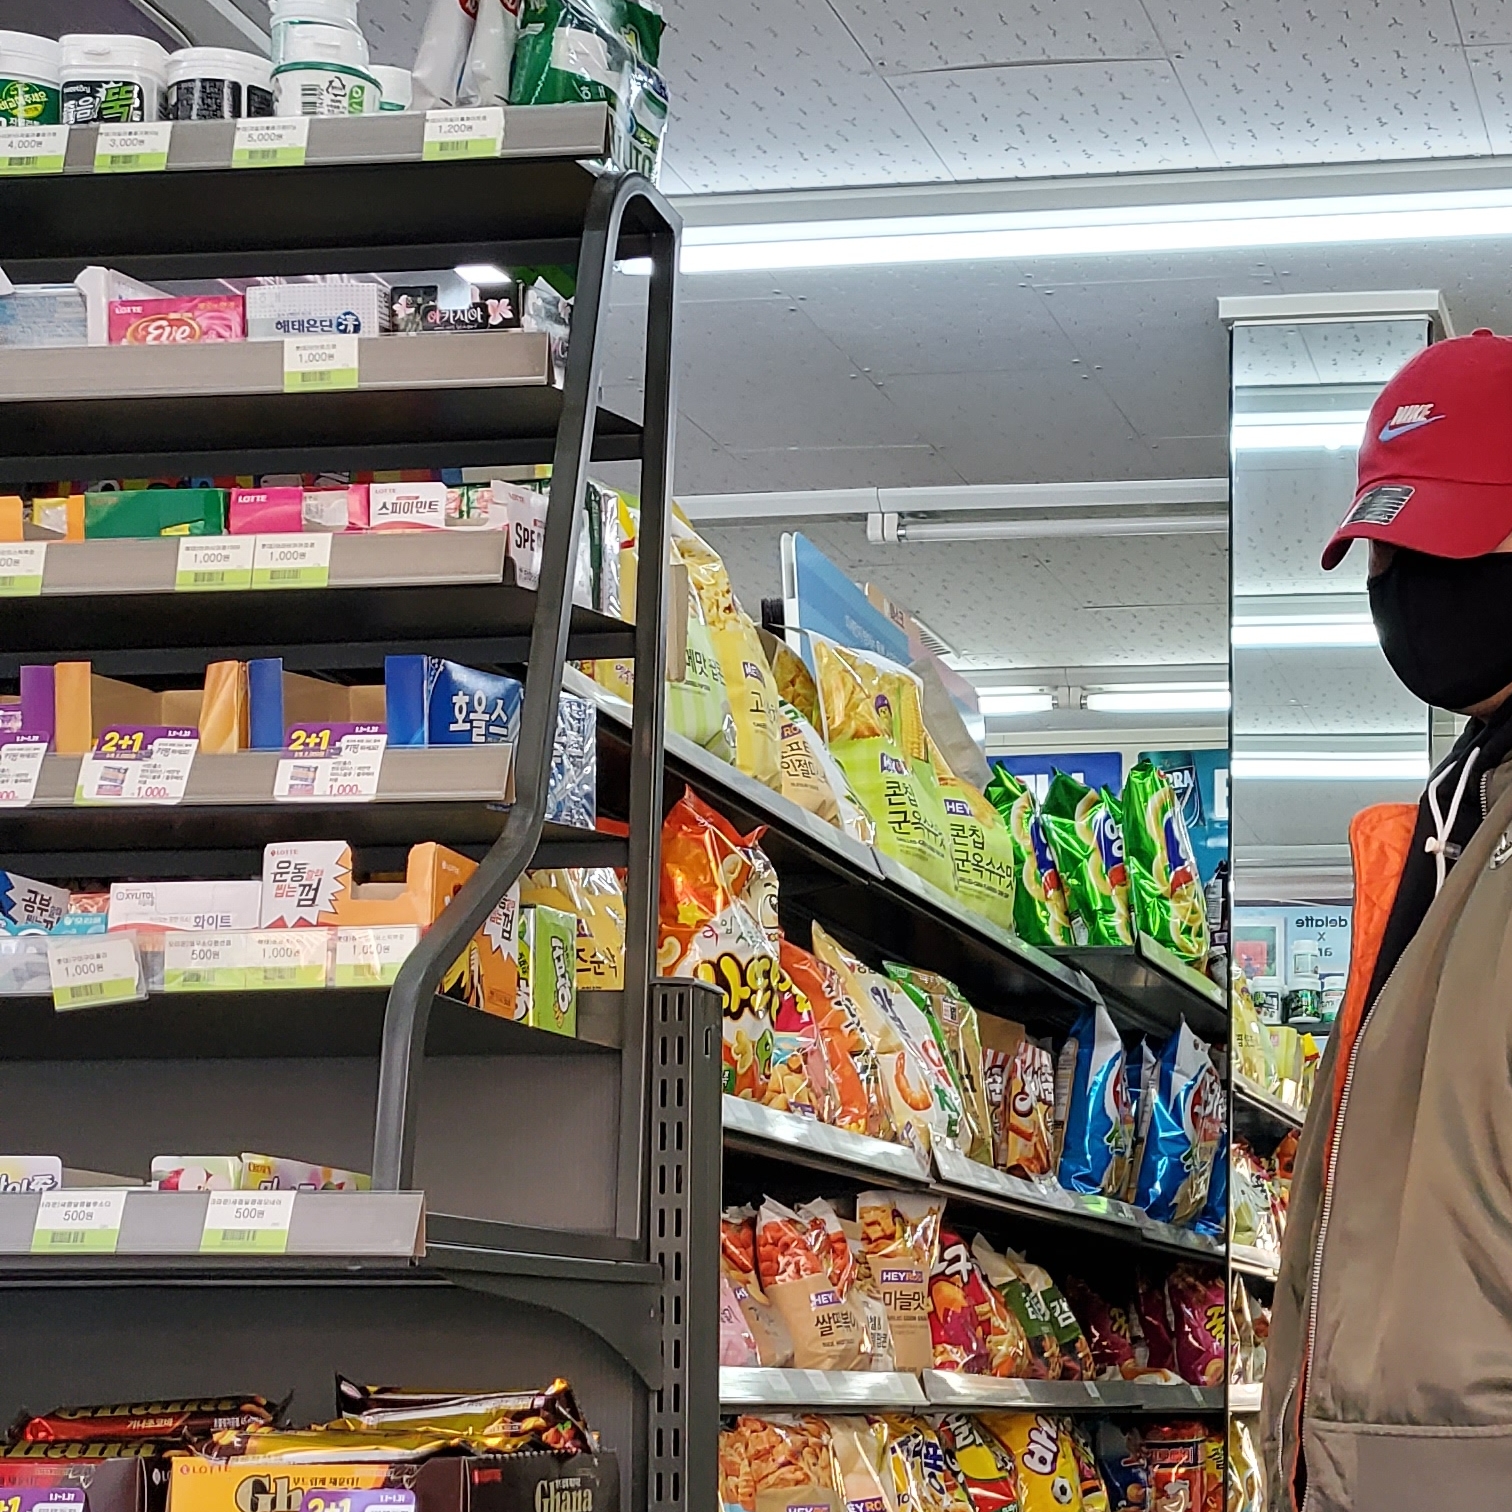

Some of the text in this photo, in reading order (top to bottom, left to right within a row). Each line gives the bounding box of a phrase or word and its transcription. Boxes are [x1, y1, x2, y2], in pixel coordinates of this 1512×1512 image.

[273, 317, 334, 333] 해태은단
[427, 308, 484, 326] 아카시아
[297, 351, 336, 364] 1,000원
[1389, 403, 1434, 426] NIKE
[238, 494, 267, 503] LOTTE
[193, 552, 231, 564] 1,000원
[269, 550, 307, 562] 1,000원
[449, 689, 509, 743] 호올스
[104, 731, 144, 753] 2+1
[289, 729, 331, 751] 2+1
[124, 890, 155, 902] XYLITOL
[193, 913, 232, 930] 화이트
[190, 947, 221, 961] 500원
[63, 962, 104, 978] 1,000원
[62, 1209, 94, 1223] 500원
[234, 1206, 265, 1220] 500원
[882, 1290, 926, 1312] 마늘맛
